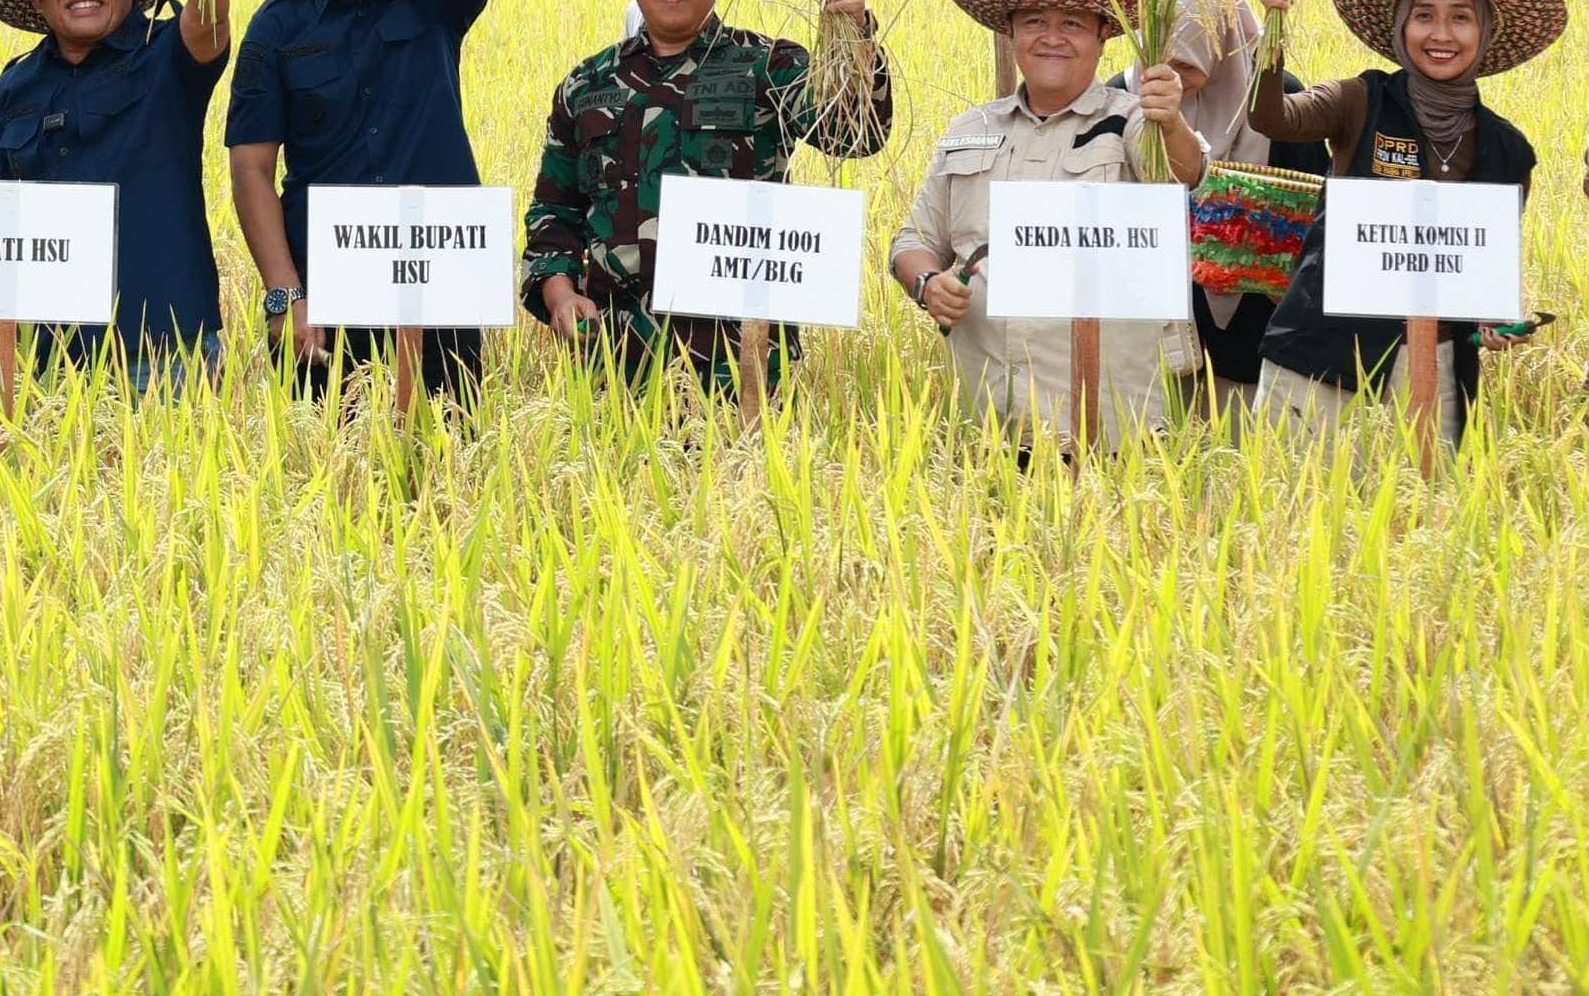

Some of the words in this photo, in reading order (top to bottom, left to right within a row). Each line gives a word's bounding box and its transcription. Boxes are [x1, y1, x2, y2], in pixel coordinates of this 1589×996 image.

[692, 81, 718, 97] TNI
[725, 80, 749, 95] AD
[1377, 136, 1419, 155] DPRD
[333, 225, 403, 249] WAKIL
[410, 225, 486, 249] BUPATI
[695, 222, 772, 250] DANDIM
[778, 230, 822, 254] 1001
[1015, 226, 1071, 247] SEKDA
[1078, 226, 1121, 248] KAB.
[1128, 227, 1159, 249] HSU
[1356, 223, 1408, 244] KETUA
[1414, 225, 1468, 246] KOMISI
[1474, 228, 1487, 247] II
[31, 238, 70, 263] HSU
[391, 260, 431, 285] HSU
[710, 256, 803, 284] AMT/BLG
[1381, 252, 1429, 273] DPRD
[1435, 254, 1463, 274] HSU
